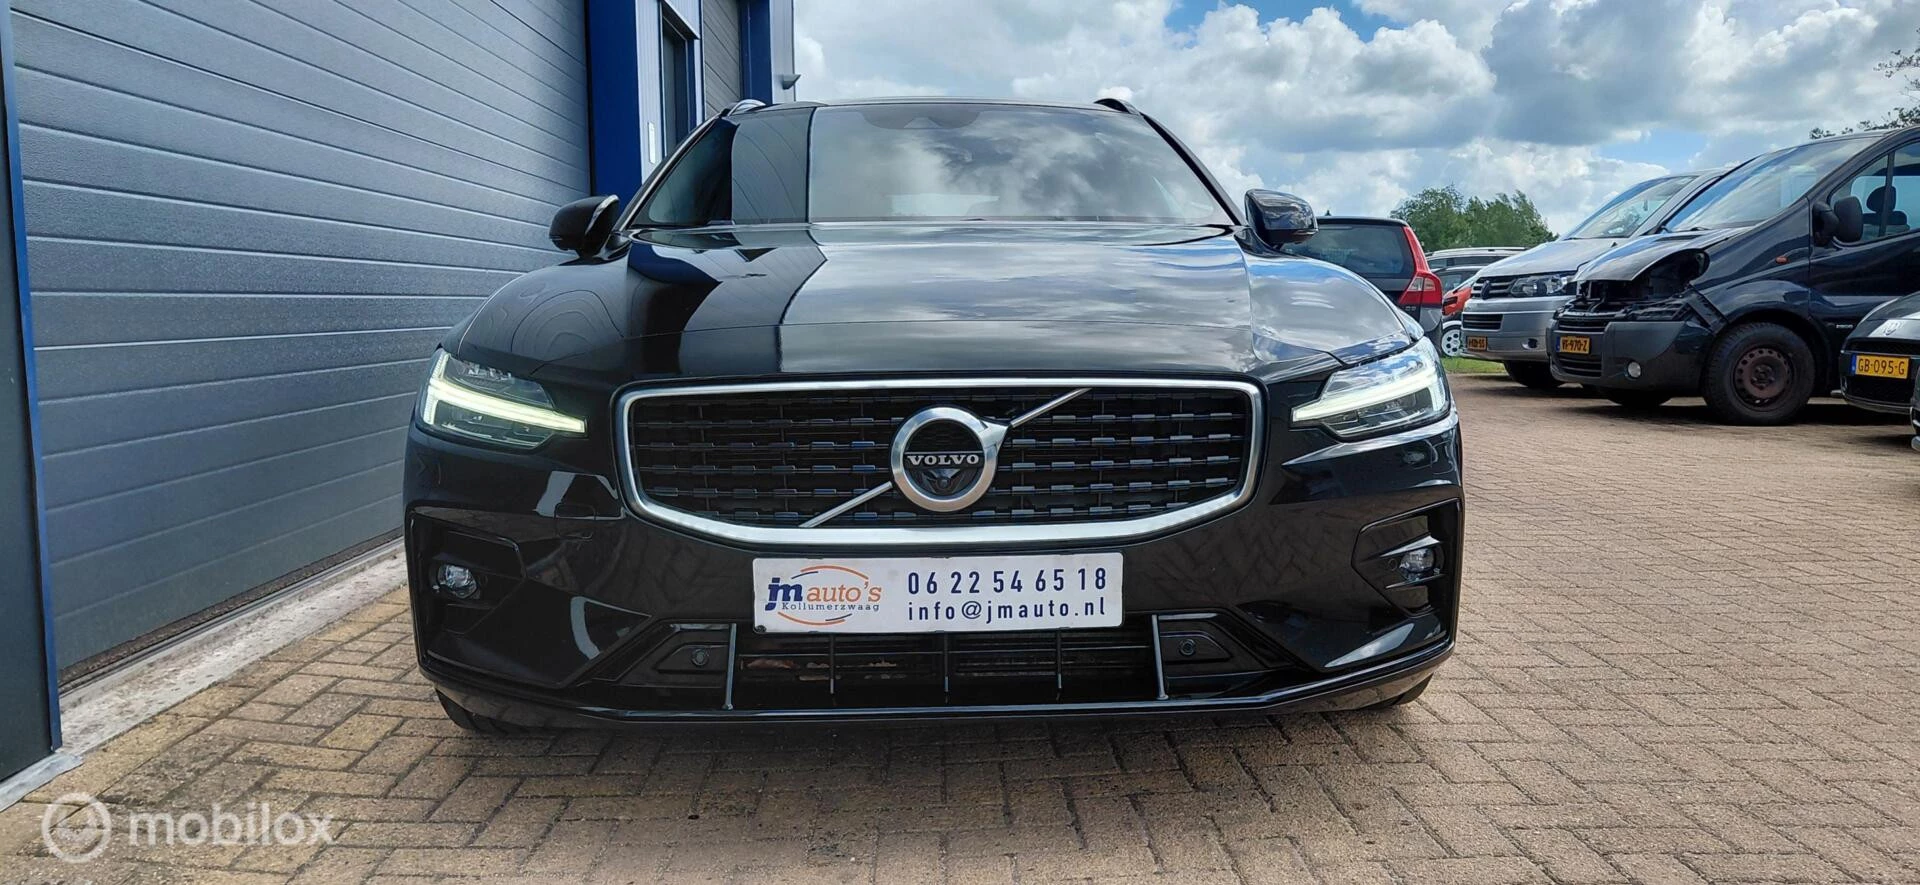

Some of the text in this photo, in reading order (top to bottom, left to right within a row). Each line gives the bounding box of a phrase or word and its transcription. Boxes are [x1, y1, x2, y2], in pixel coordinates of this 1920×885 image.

[1858, 358, 1905, 375] GB-095-G
[907, 455, 980, 466] VOLVO
[908, 567, 1106, 595] 06 22 54 65 18
[781, 601, 880, 613] Kollumerzwaag
[908, 597, 1106, 624] info@jmauto.nl
